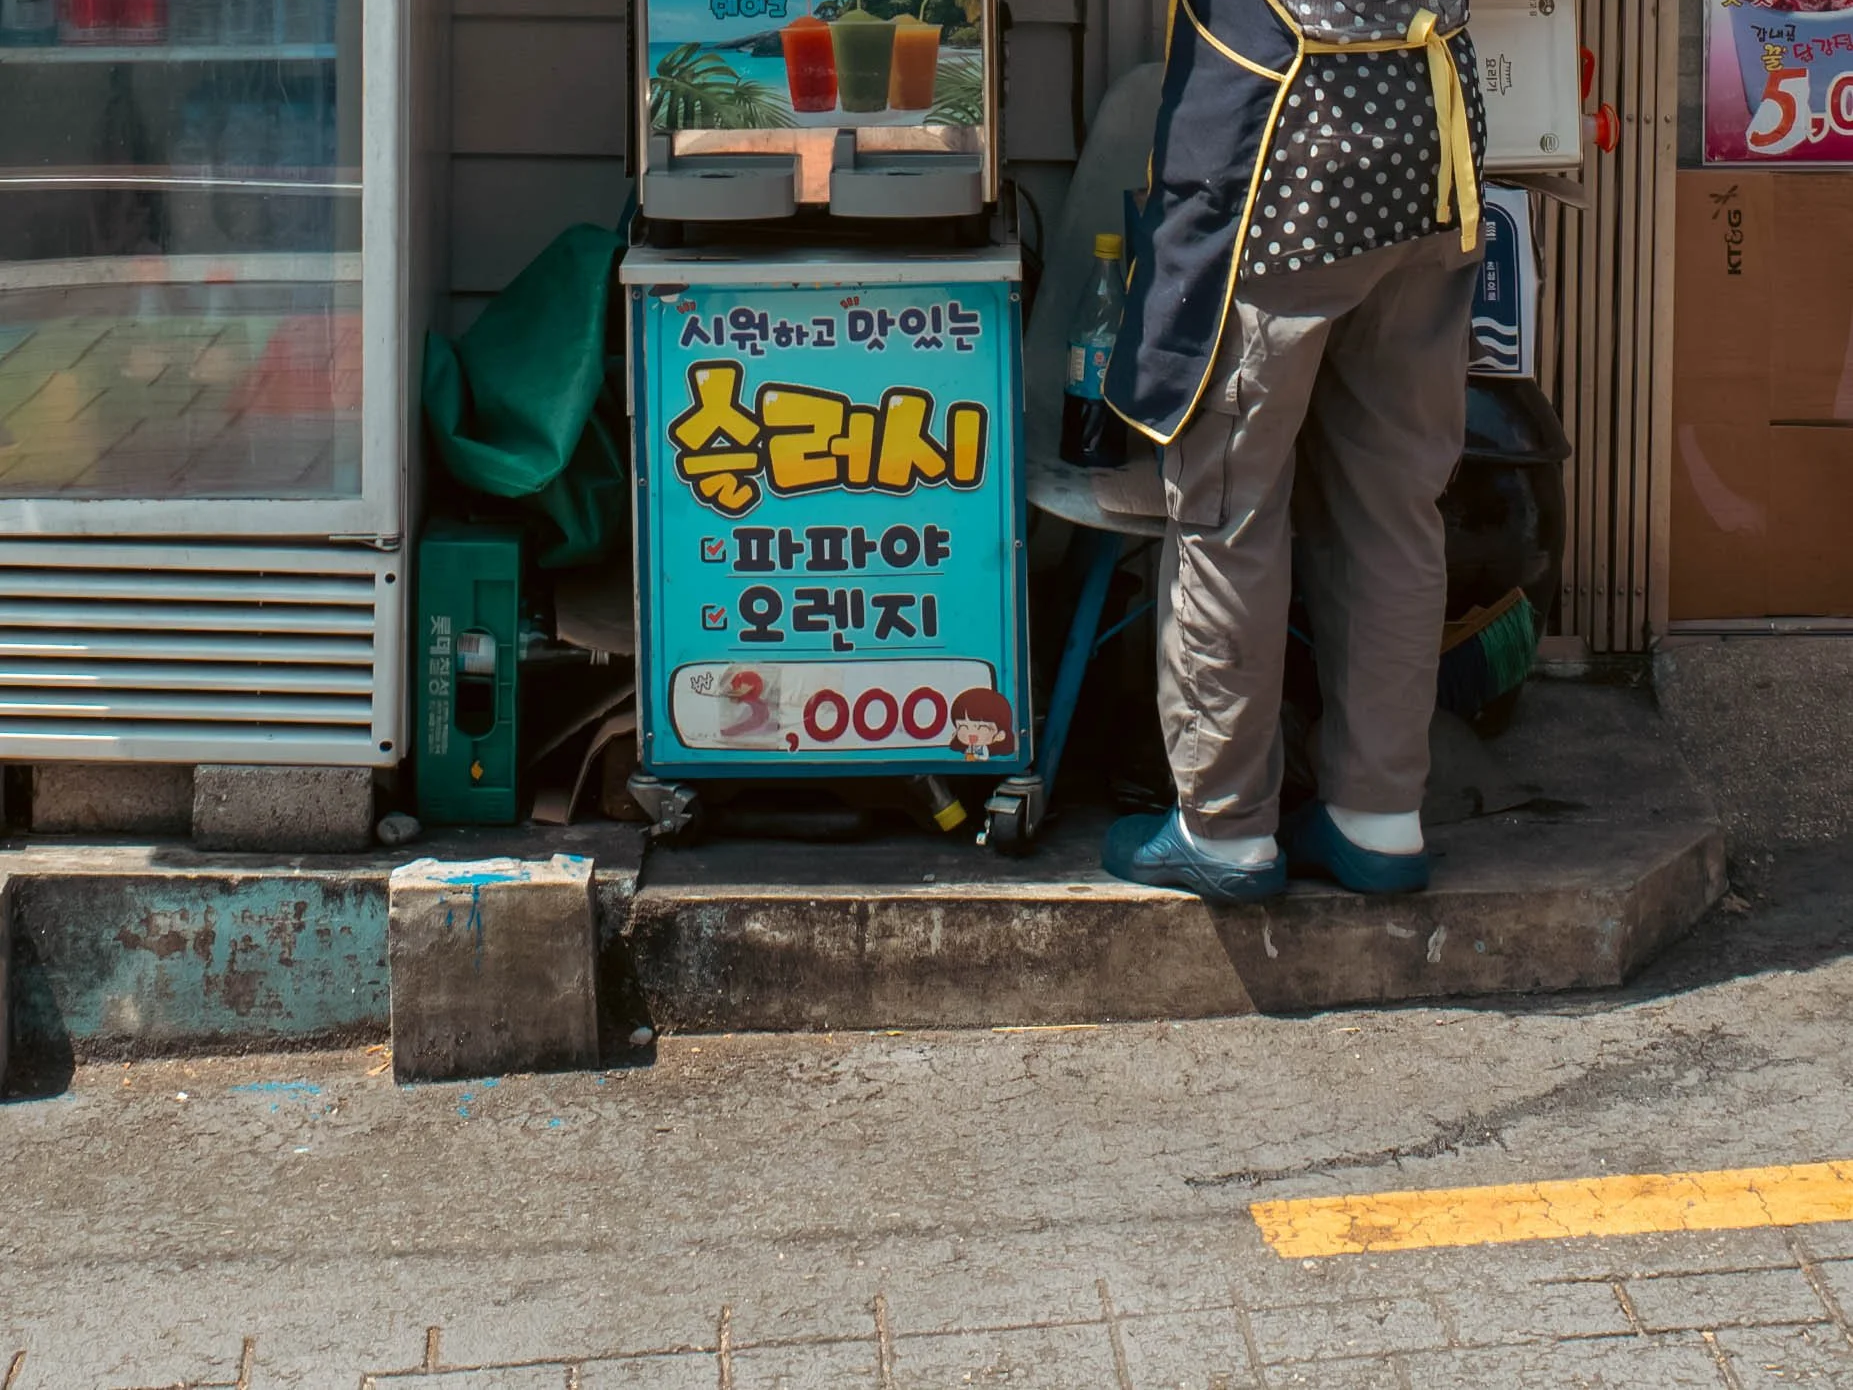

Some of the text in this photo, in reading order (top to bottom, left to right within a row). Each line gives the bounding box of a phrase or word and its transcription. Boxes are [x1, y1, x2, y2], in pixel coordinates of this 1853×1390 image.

[1724, 210, 1744, 275] KT&G
[680, 302, 982, 357] 시원하고 맛있는
[668, 360, 988, 518] 슬러시
[731, 524, 951, 573] 파파야
[737, 585, 939, 652] 오렌지
